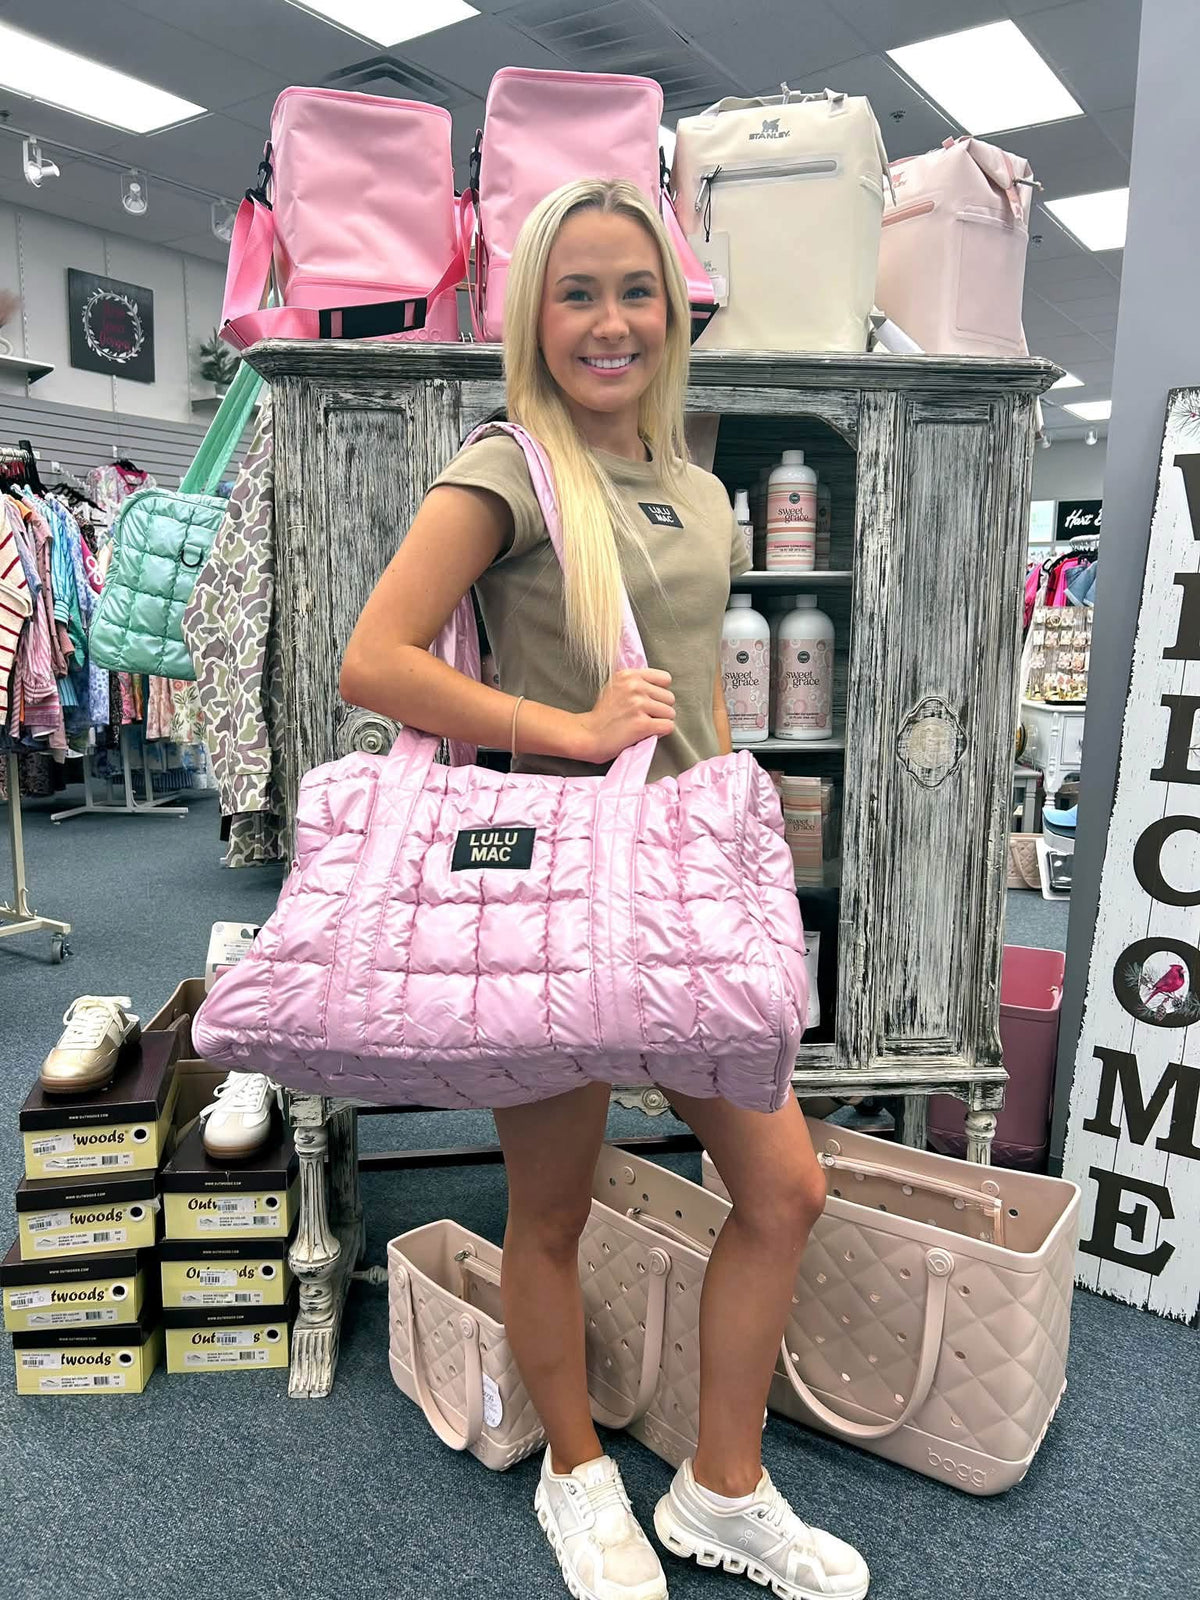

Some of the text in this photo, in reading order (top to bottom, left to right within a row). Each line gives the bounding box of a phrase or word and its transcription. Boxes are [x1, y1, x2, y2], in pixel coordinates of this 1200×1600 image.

[749, 130, 790, 140] STANLEY
[648, 506, 671, 516] LULU
[778, 507, 804, 517] sweet
[655, 513, 675, 523] MAC
[784, 514, 809, 523] grace
[724, 670, 753, 680] sweet
[785, 670, 813, 680] sweet
[731, 678, 760, 689] grace
[792, 678, 820, 689] grace
[469, 832, 518, 846] LULU
[470, 846, 512, 862] MAC
[1079, 453, 1200, 1276] LCOME
[70, 1208, 123, 1225] twoods
[50, 1286, 105, 1303] twoods
[60, 1352, 112, 1366] twoods
[928, 1447, 987, 1488] bogg
